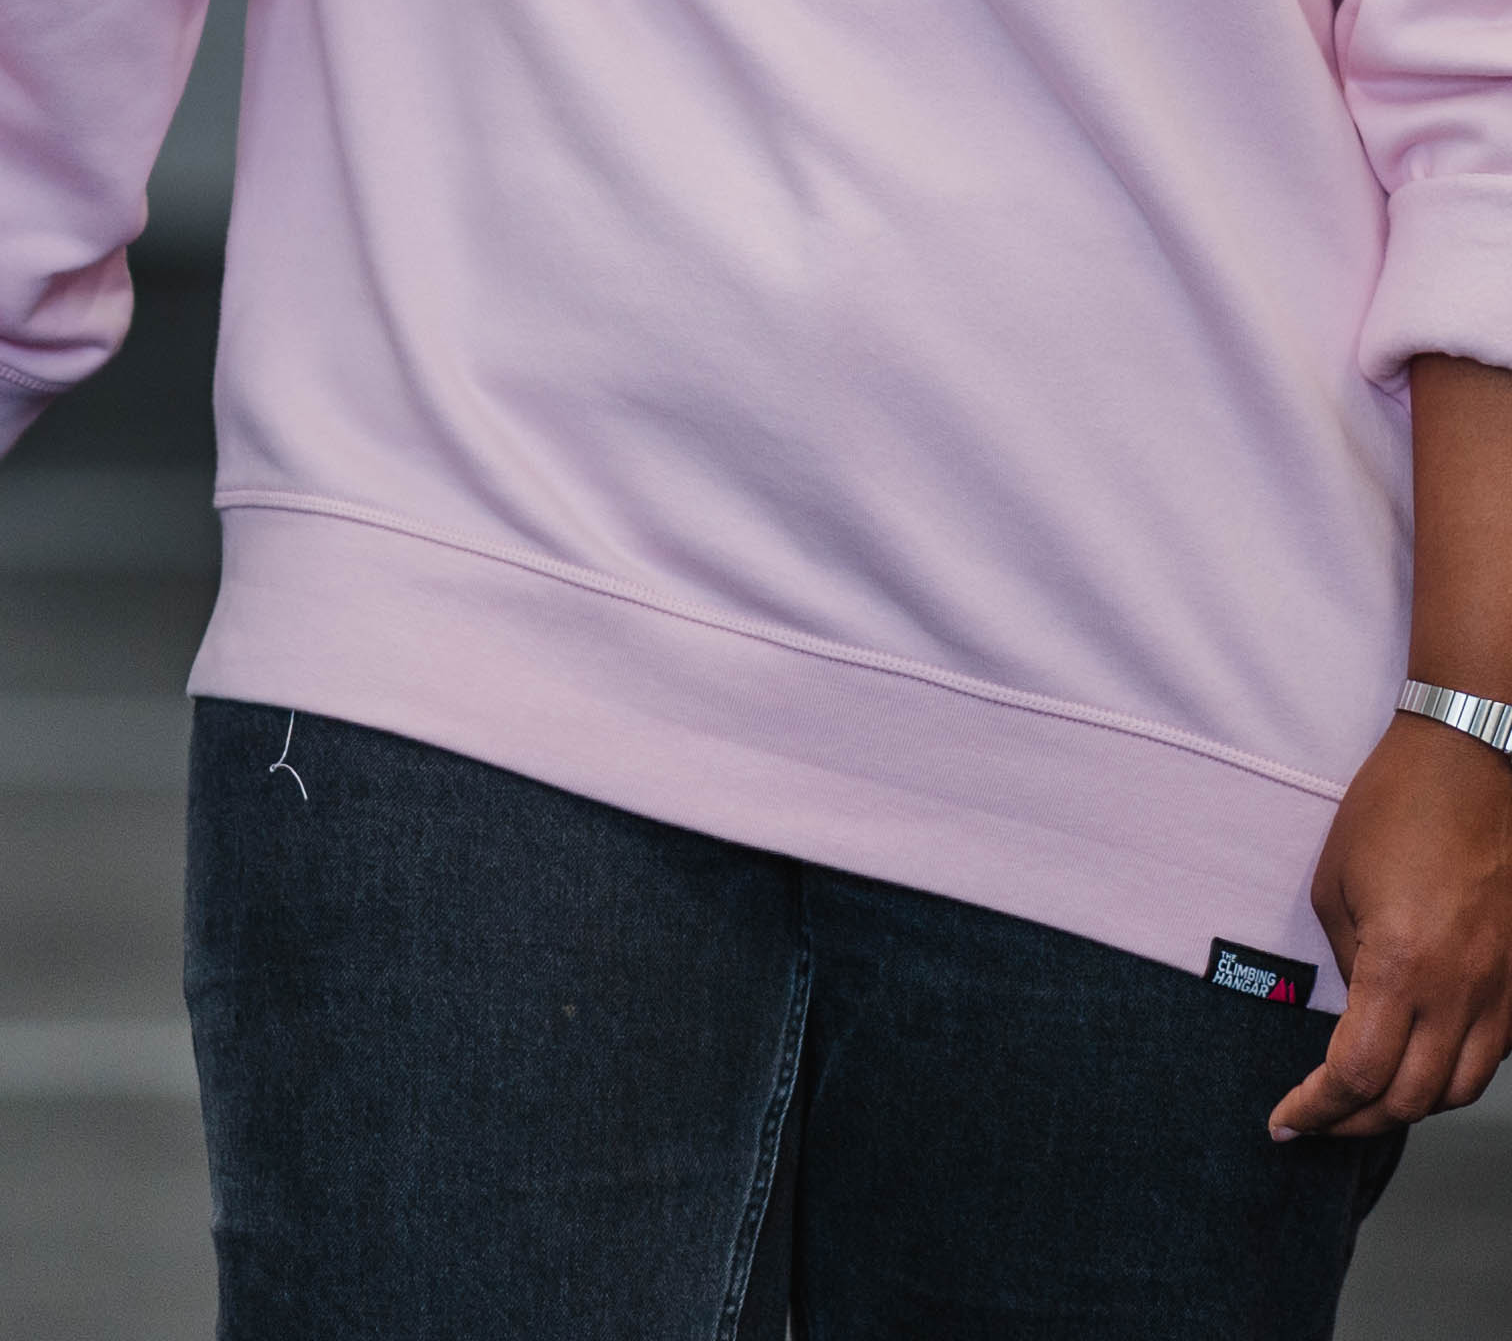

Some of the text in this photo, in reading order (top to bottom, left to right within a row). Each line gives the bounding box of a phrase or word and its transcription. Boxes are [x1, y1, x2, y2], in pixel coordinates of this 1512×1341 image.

[1221, 950, 1238, 963] THE
[1212, 971, 1270, 999] HANGAR
[1218, 959, 1277, 986] CLIMBING
